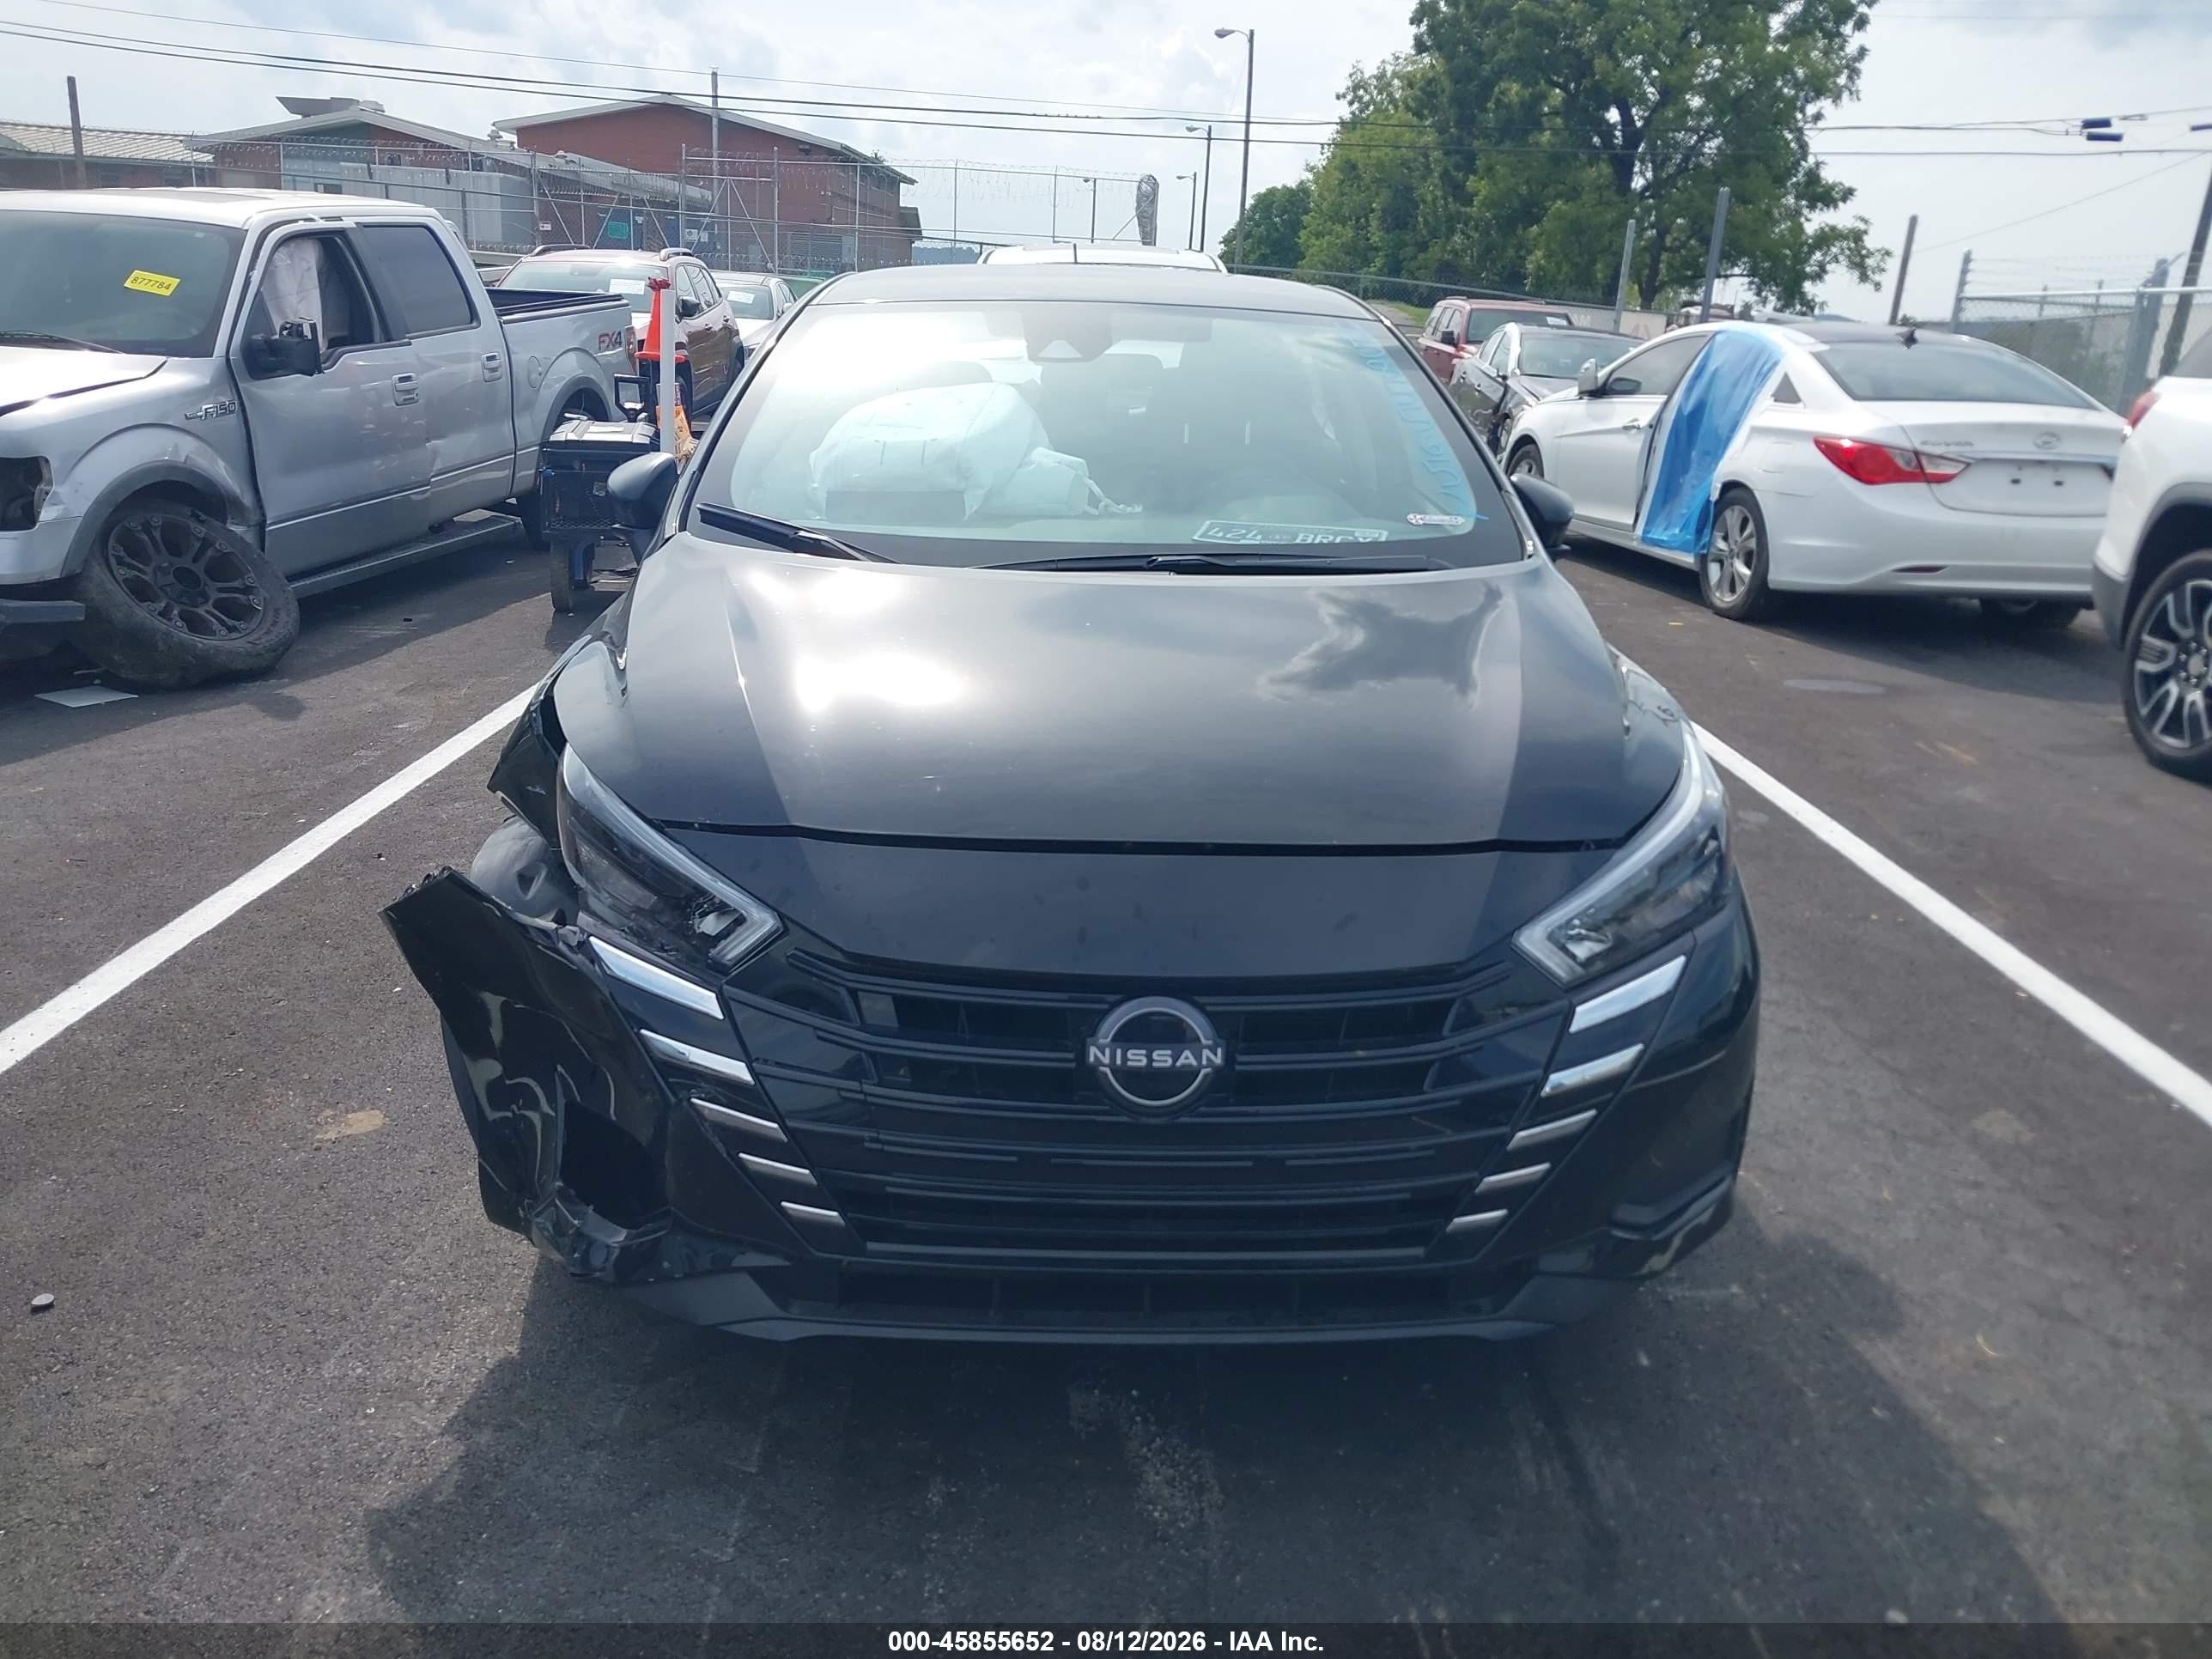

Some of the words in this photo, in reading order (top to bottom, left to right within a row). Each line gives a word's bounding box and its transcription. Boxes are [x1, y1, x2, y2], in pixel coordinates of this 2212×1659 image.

[131, 276, 172, 290] 877784
[598, 331, 622, 350] FX4
[1206, 527, 1264, 540] 424
[1088, 1045, 1222, 1067] NISSAN
